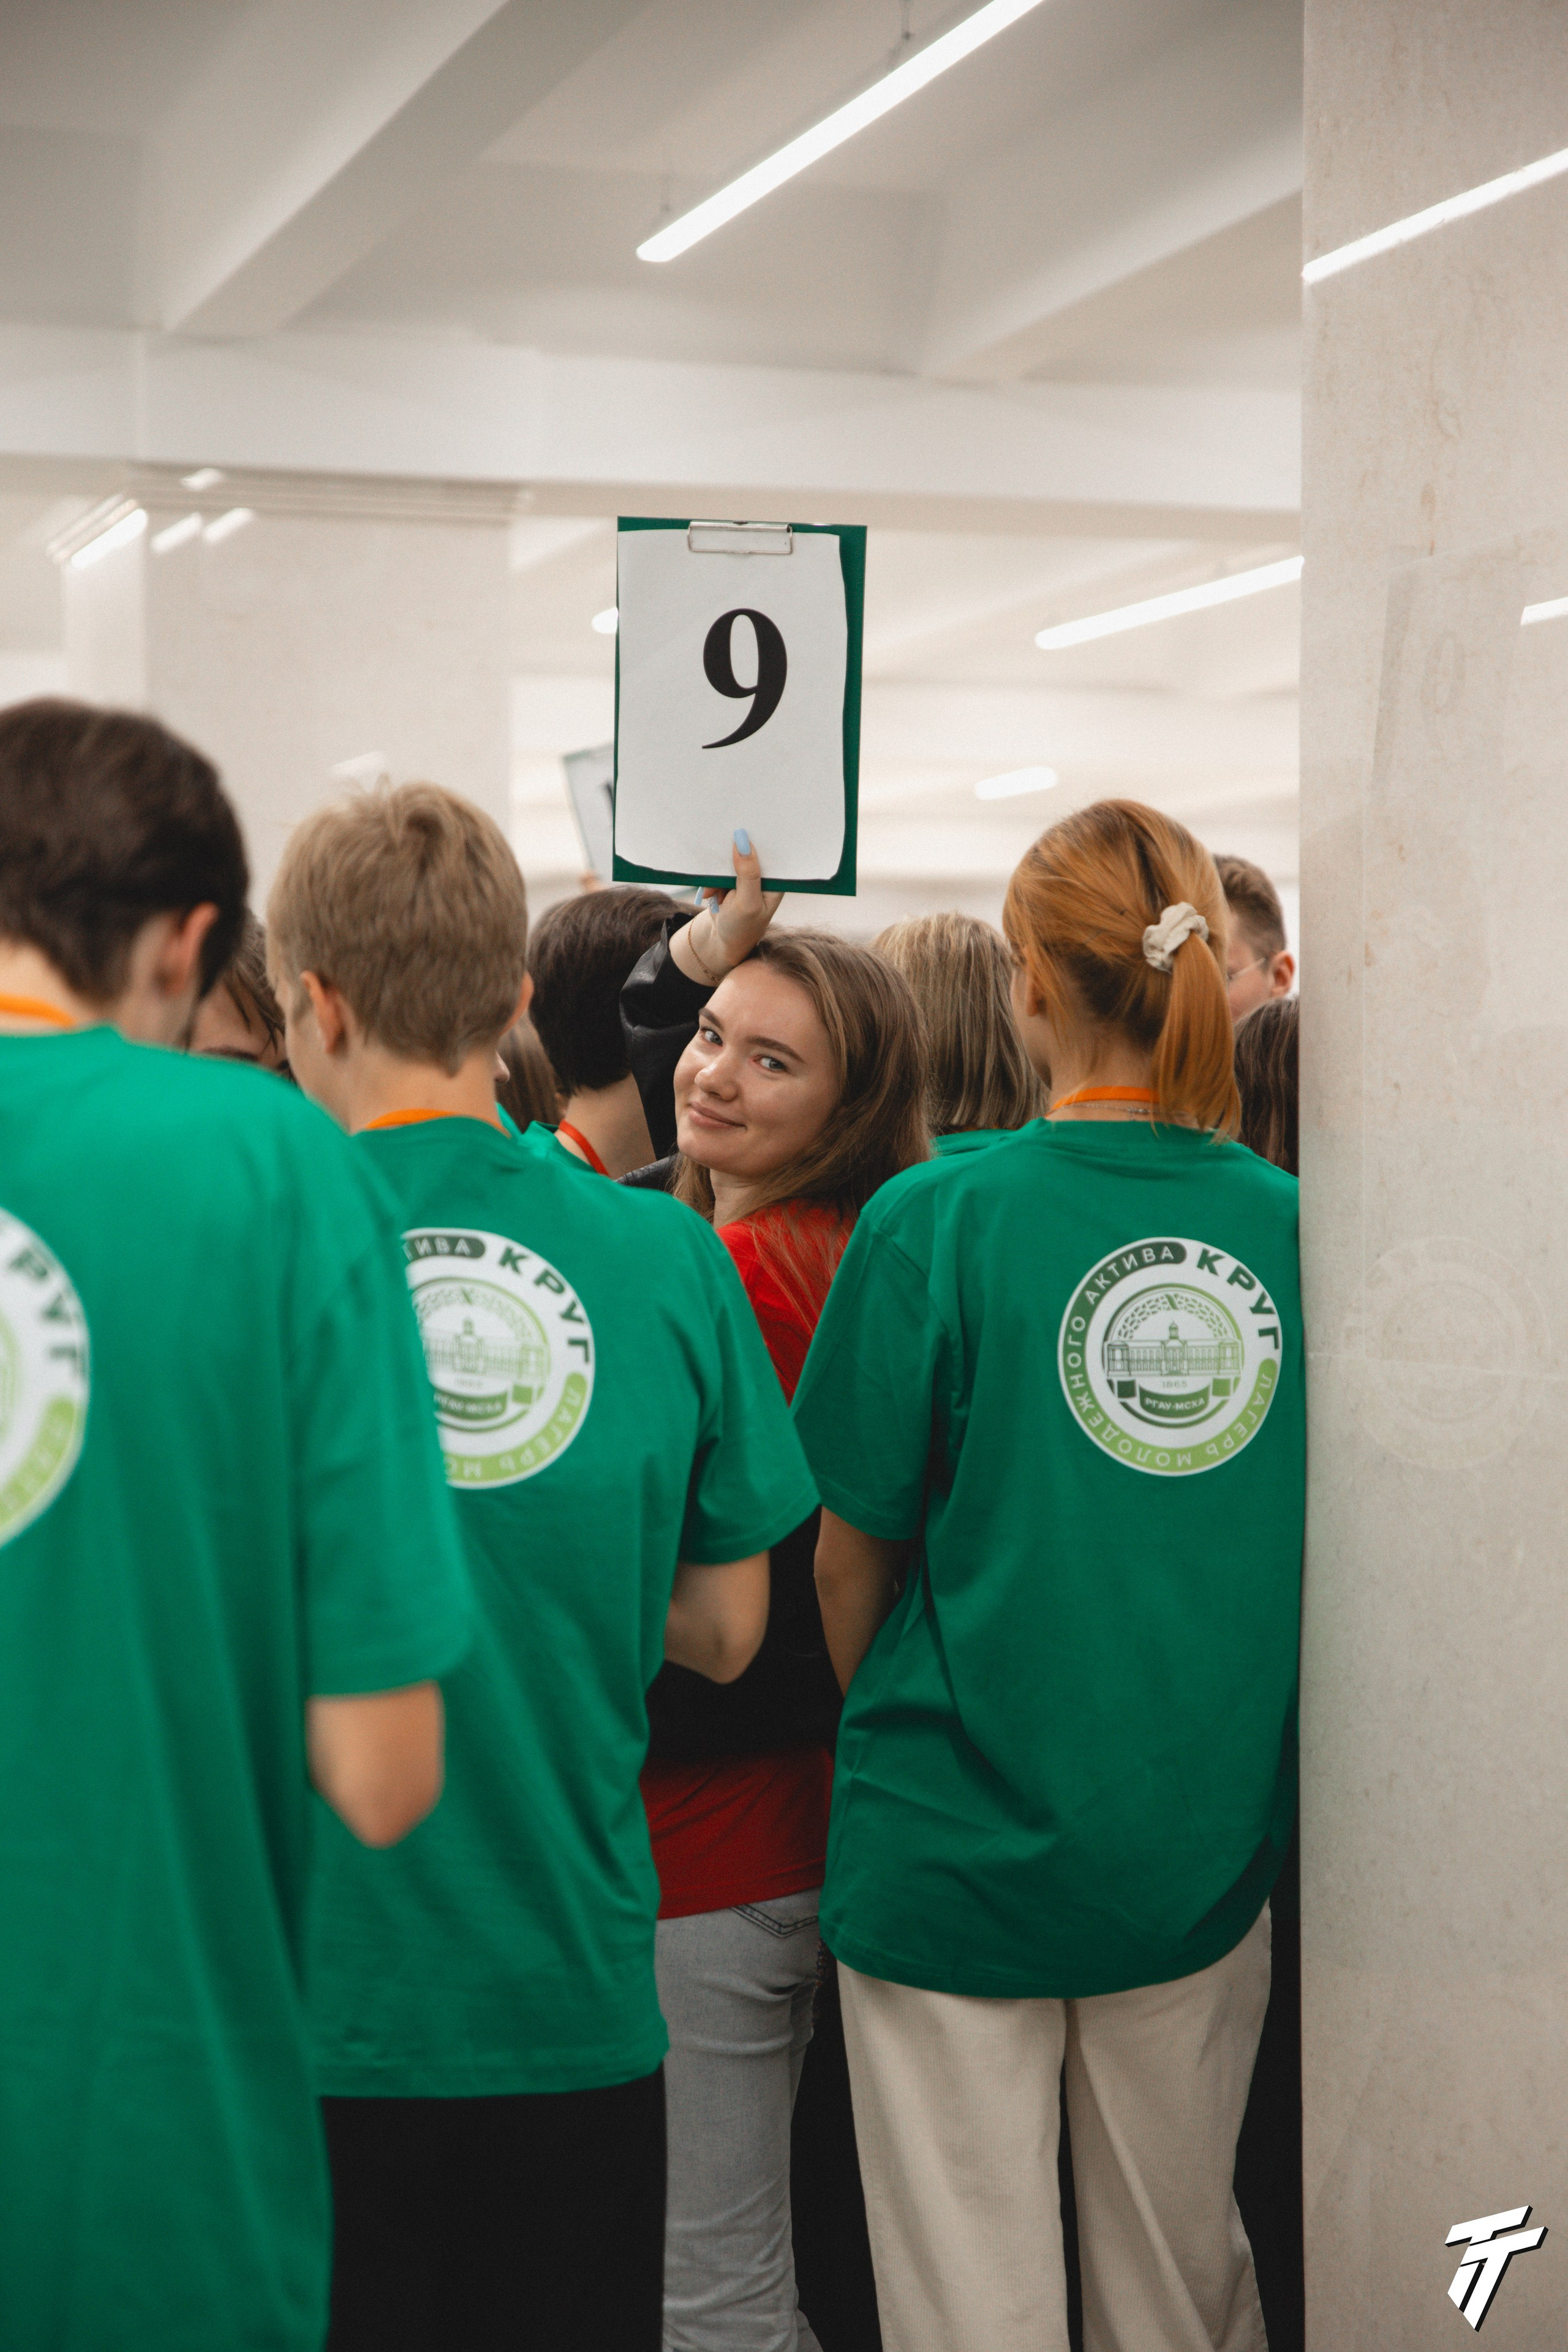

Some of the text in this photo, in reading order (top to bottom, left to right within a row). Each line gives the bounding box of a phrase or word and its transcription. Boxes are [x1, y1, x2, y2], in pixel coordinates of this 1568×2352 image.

[701, 608, 788, 749] 9
[499, 1246, 590, 1364] КРУГ
[1066, 1245, 1273, 1466] ЛАГЕРЬ МОЛОДЕЖНОГО АКТИВА
[1197, 1247, 1280, 1350] КРУГ
[1161, 1380, 1188, 1389] 1865
